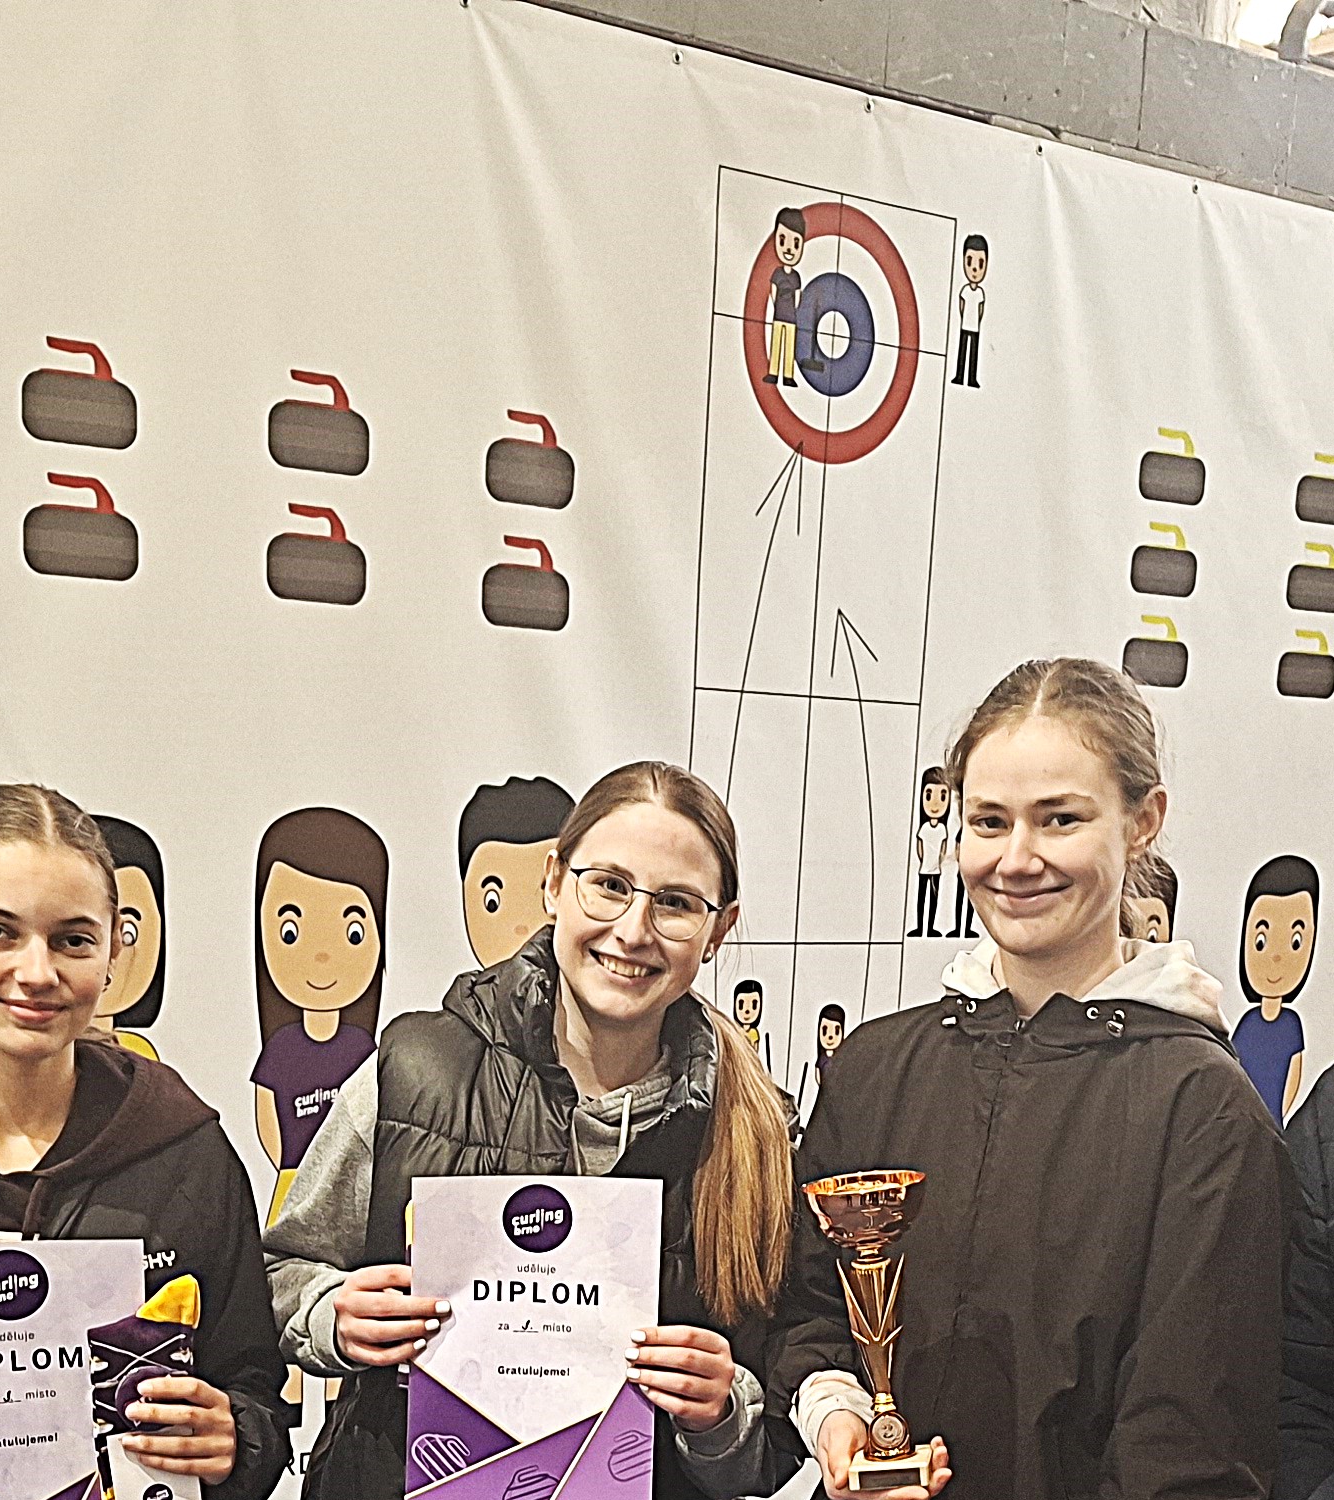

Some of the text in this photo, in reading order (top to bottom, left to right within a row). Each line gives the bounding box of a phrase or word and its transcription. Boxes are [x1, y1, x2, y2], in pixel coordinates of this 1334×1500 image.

[511, 1208, 564, 1231] curling
[513, 1224, 541, 1236] brno
[473, 1279, 599, 1306] DIPLOM
[497, 1322, 510, 1331] za
[497, 1365, 571, 1378] Gratulujeme!
